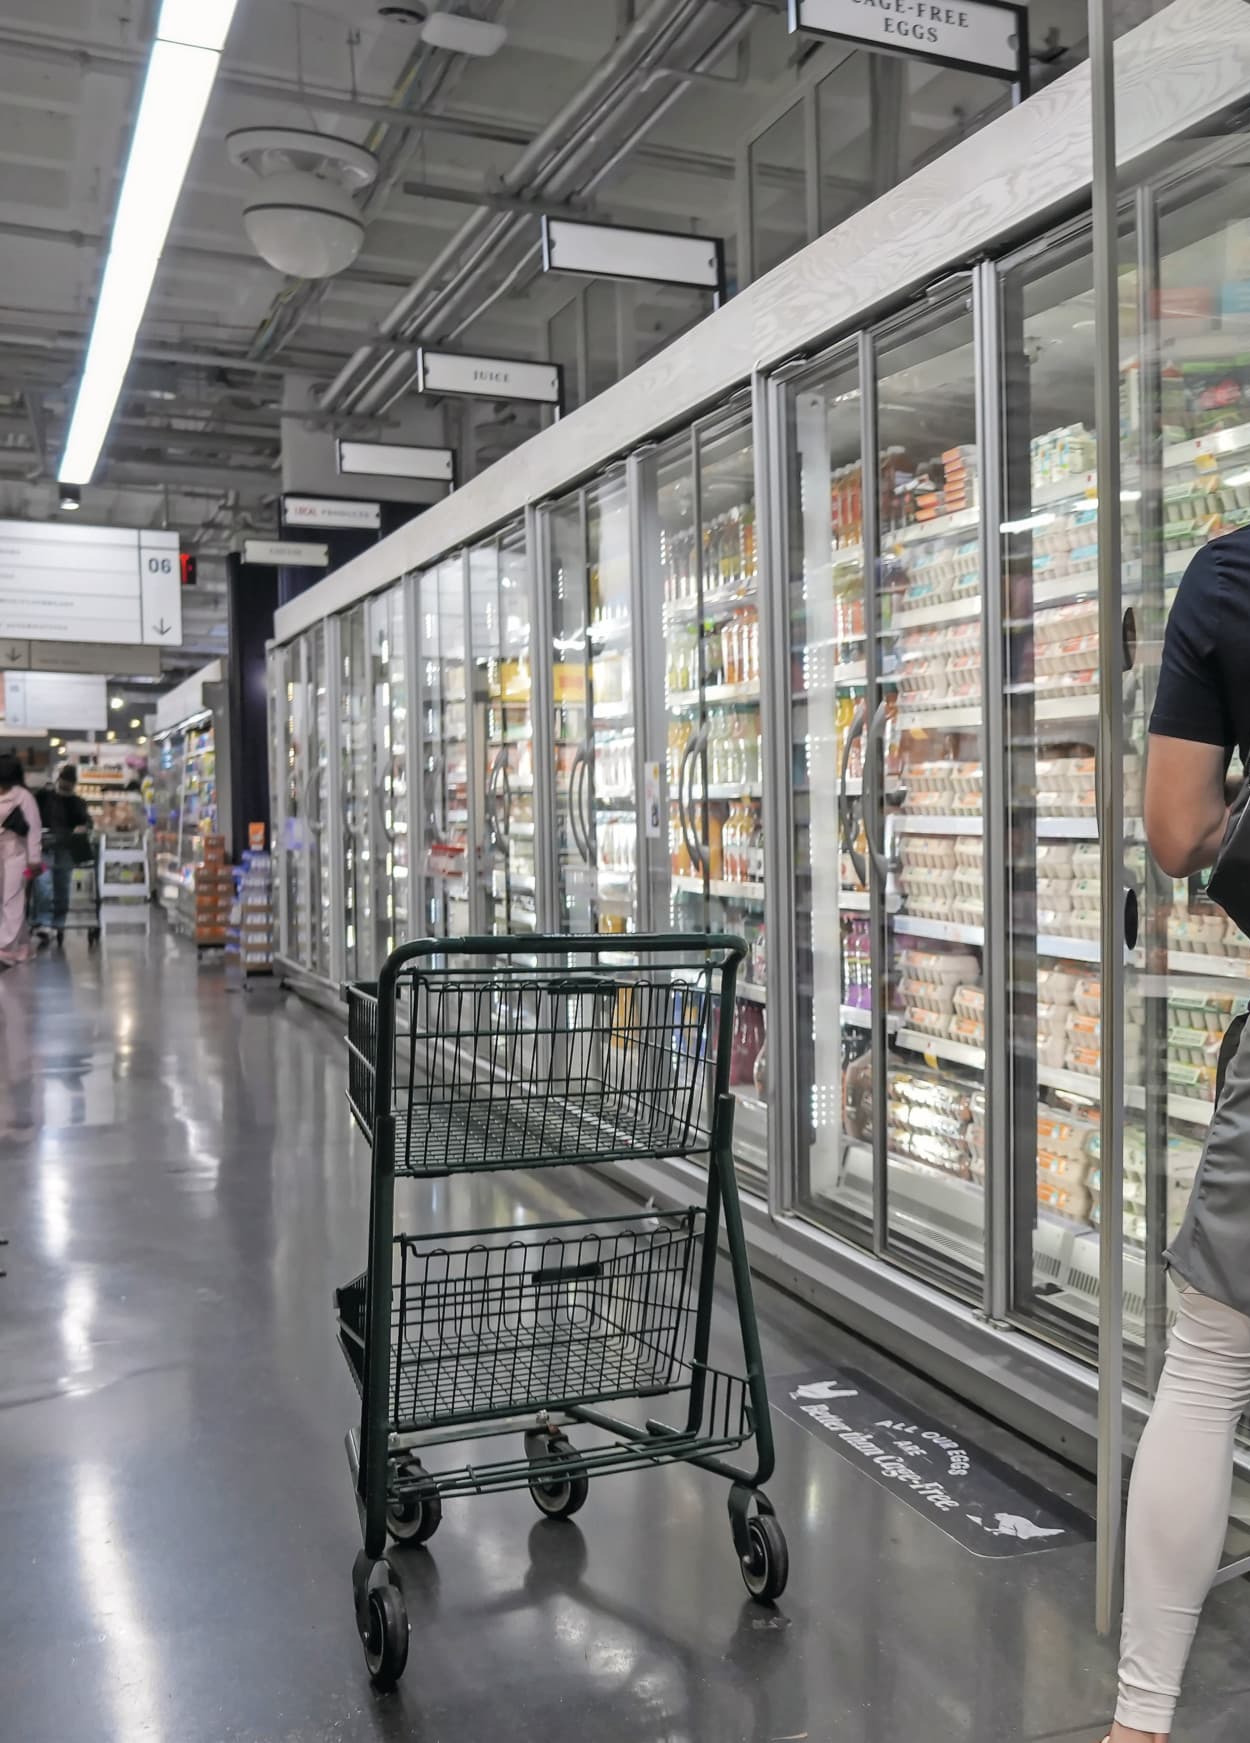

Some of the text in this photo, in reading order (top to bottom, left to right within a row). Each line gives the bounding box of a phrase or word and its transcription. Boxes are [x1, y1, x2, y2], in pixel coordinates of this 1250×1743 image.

[855, 0, 969, 28] AGE-FREE
[884, 17, 939, 43] EGGS
[148, 558, 172, 574] 06
[838, 1428, 885, 1457] than
[873, 1419, 971, 1477] ALL OUR EGGS
[892, 1440, 928, 1458] ARE
